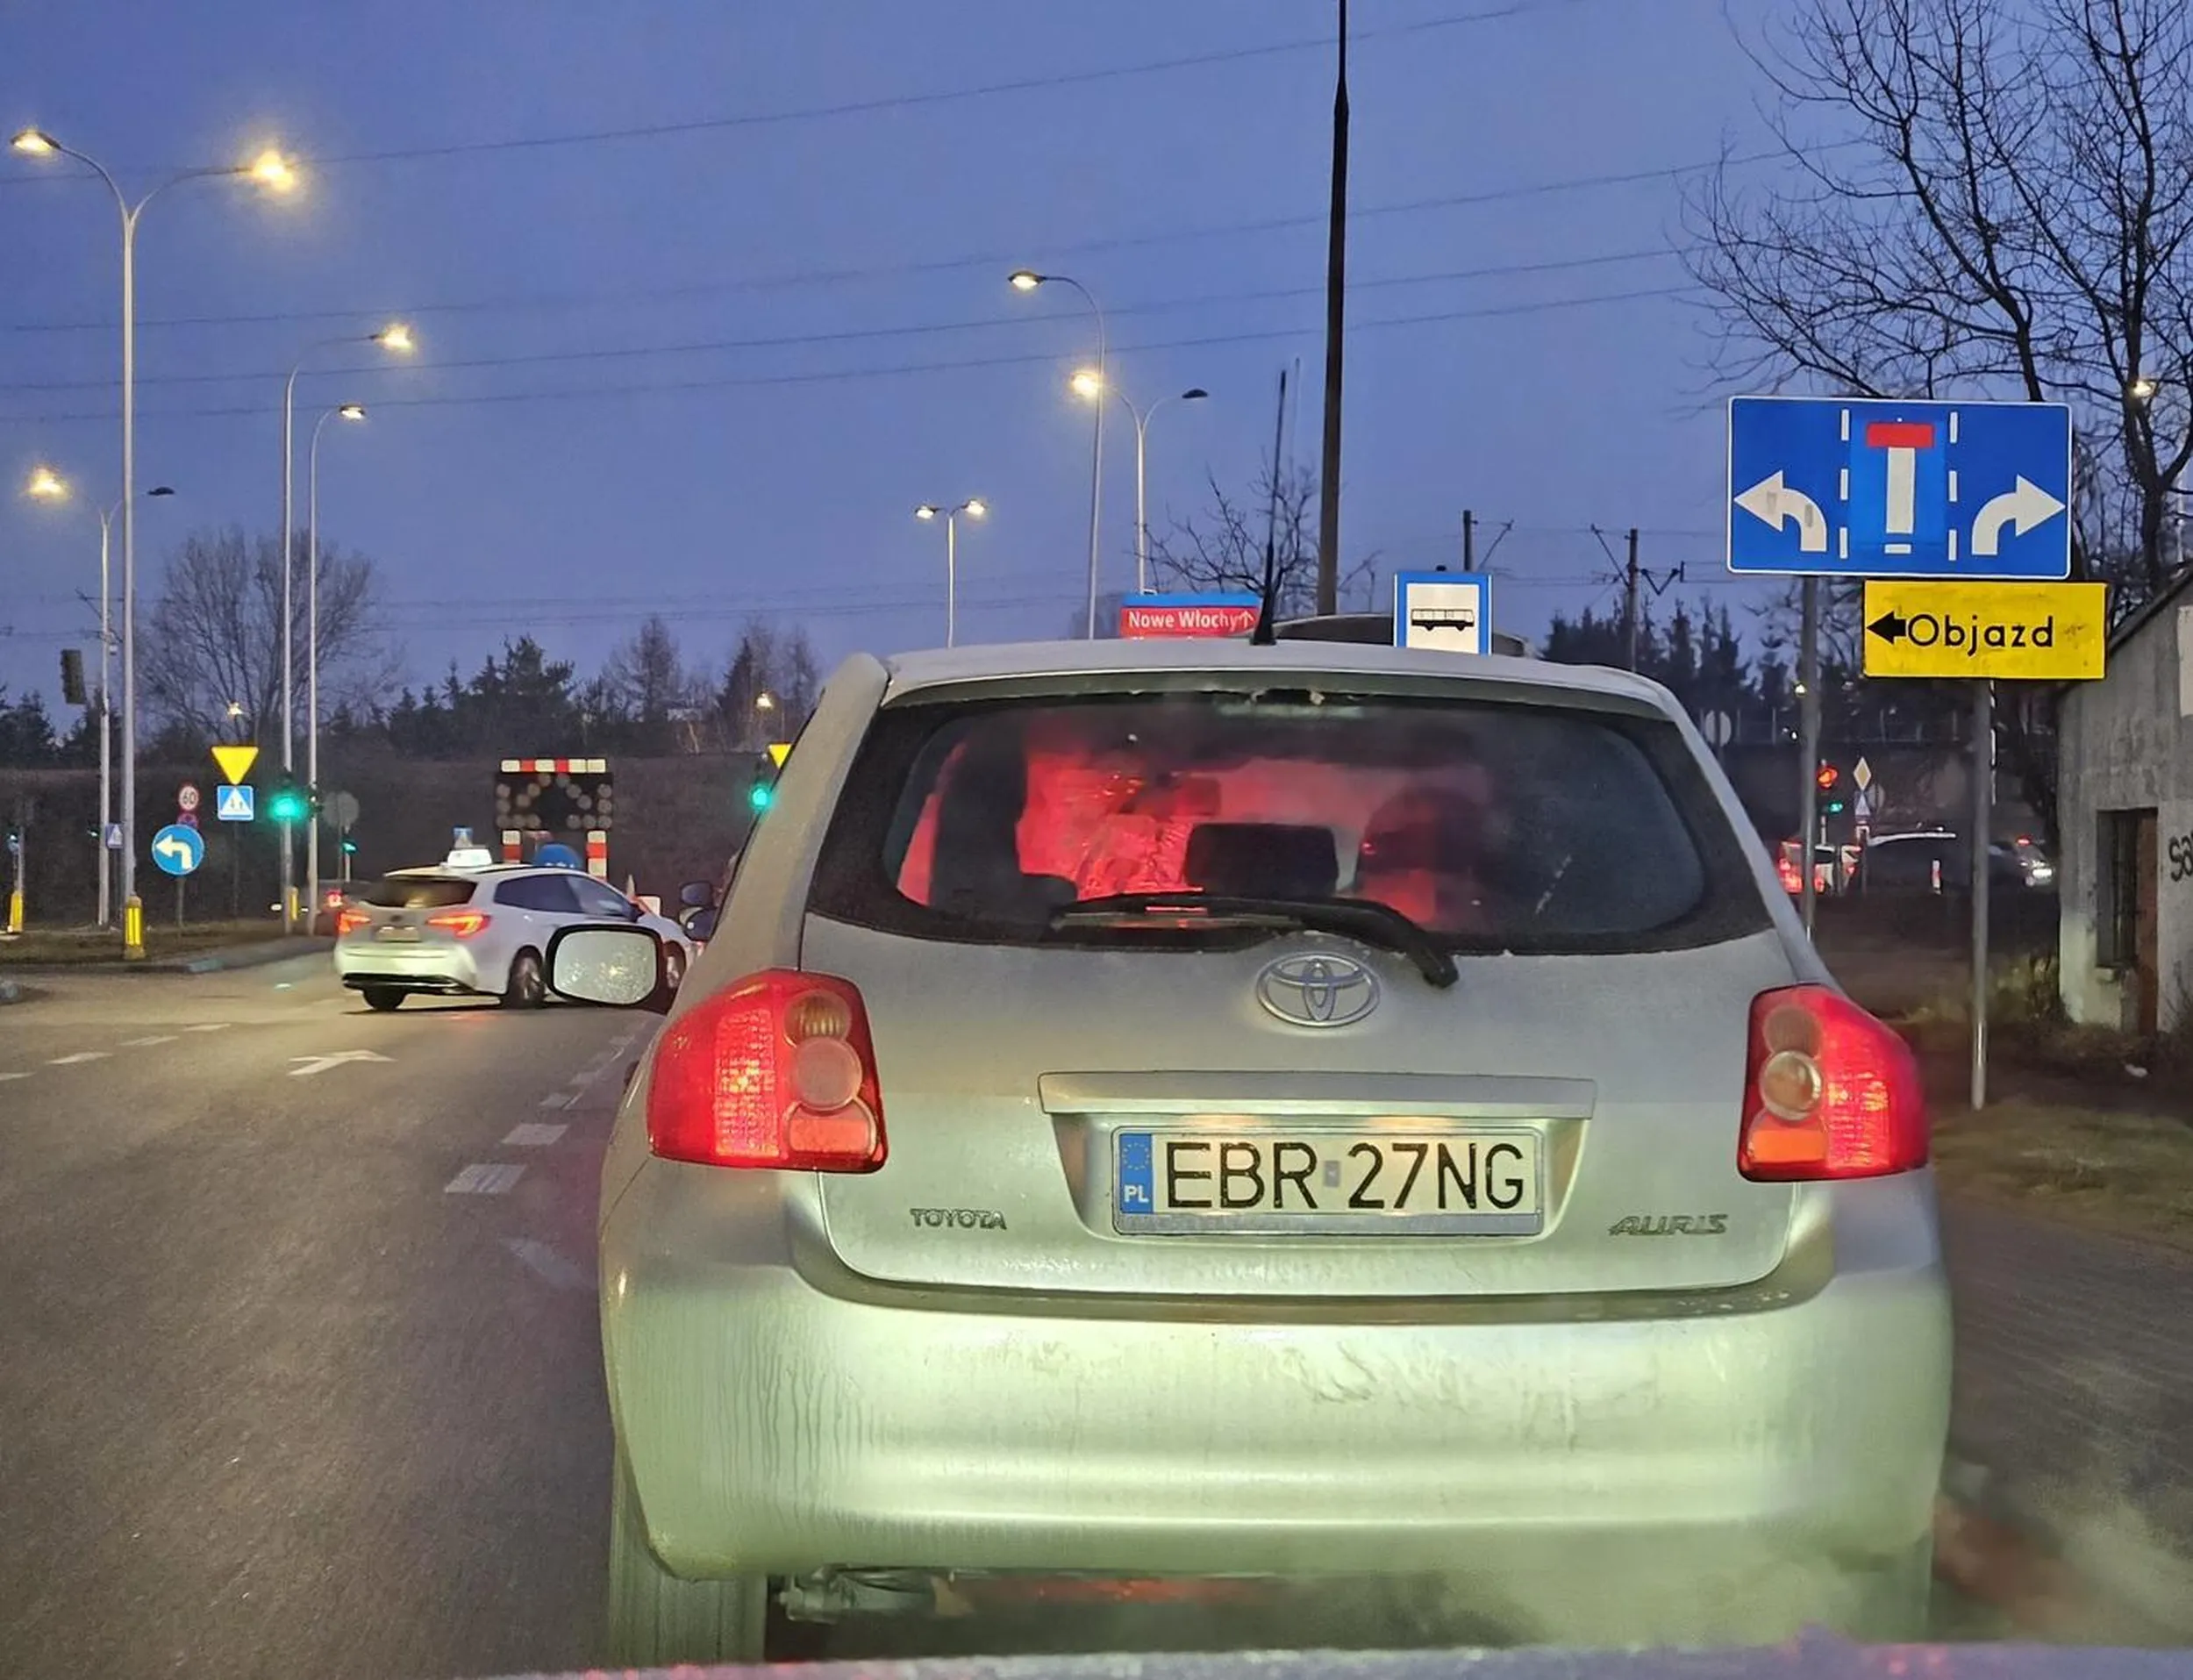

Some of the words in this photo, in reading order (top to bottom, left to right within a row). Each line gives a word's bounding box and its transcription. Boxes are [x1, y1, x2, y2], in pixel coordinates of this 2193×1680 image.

[1128, 611, 1175, 629] Nowe
[1178, 609, 1239, 632] Włochy
[1908, 613, 2054, 657] Objazd
[182, 790, 197, 805] 60
[1167, 1142, 1318, 1209] EBR
[1347, 1143, 1525, 1209] 27NG
[1124, 1185, 1149, 1203] PL
[910, 1208, 1007, 1230] TOYOTA
[1608, 1213, 1729, 1236] AURIS
